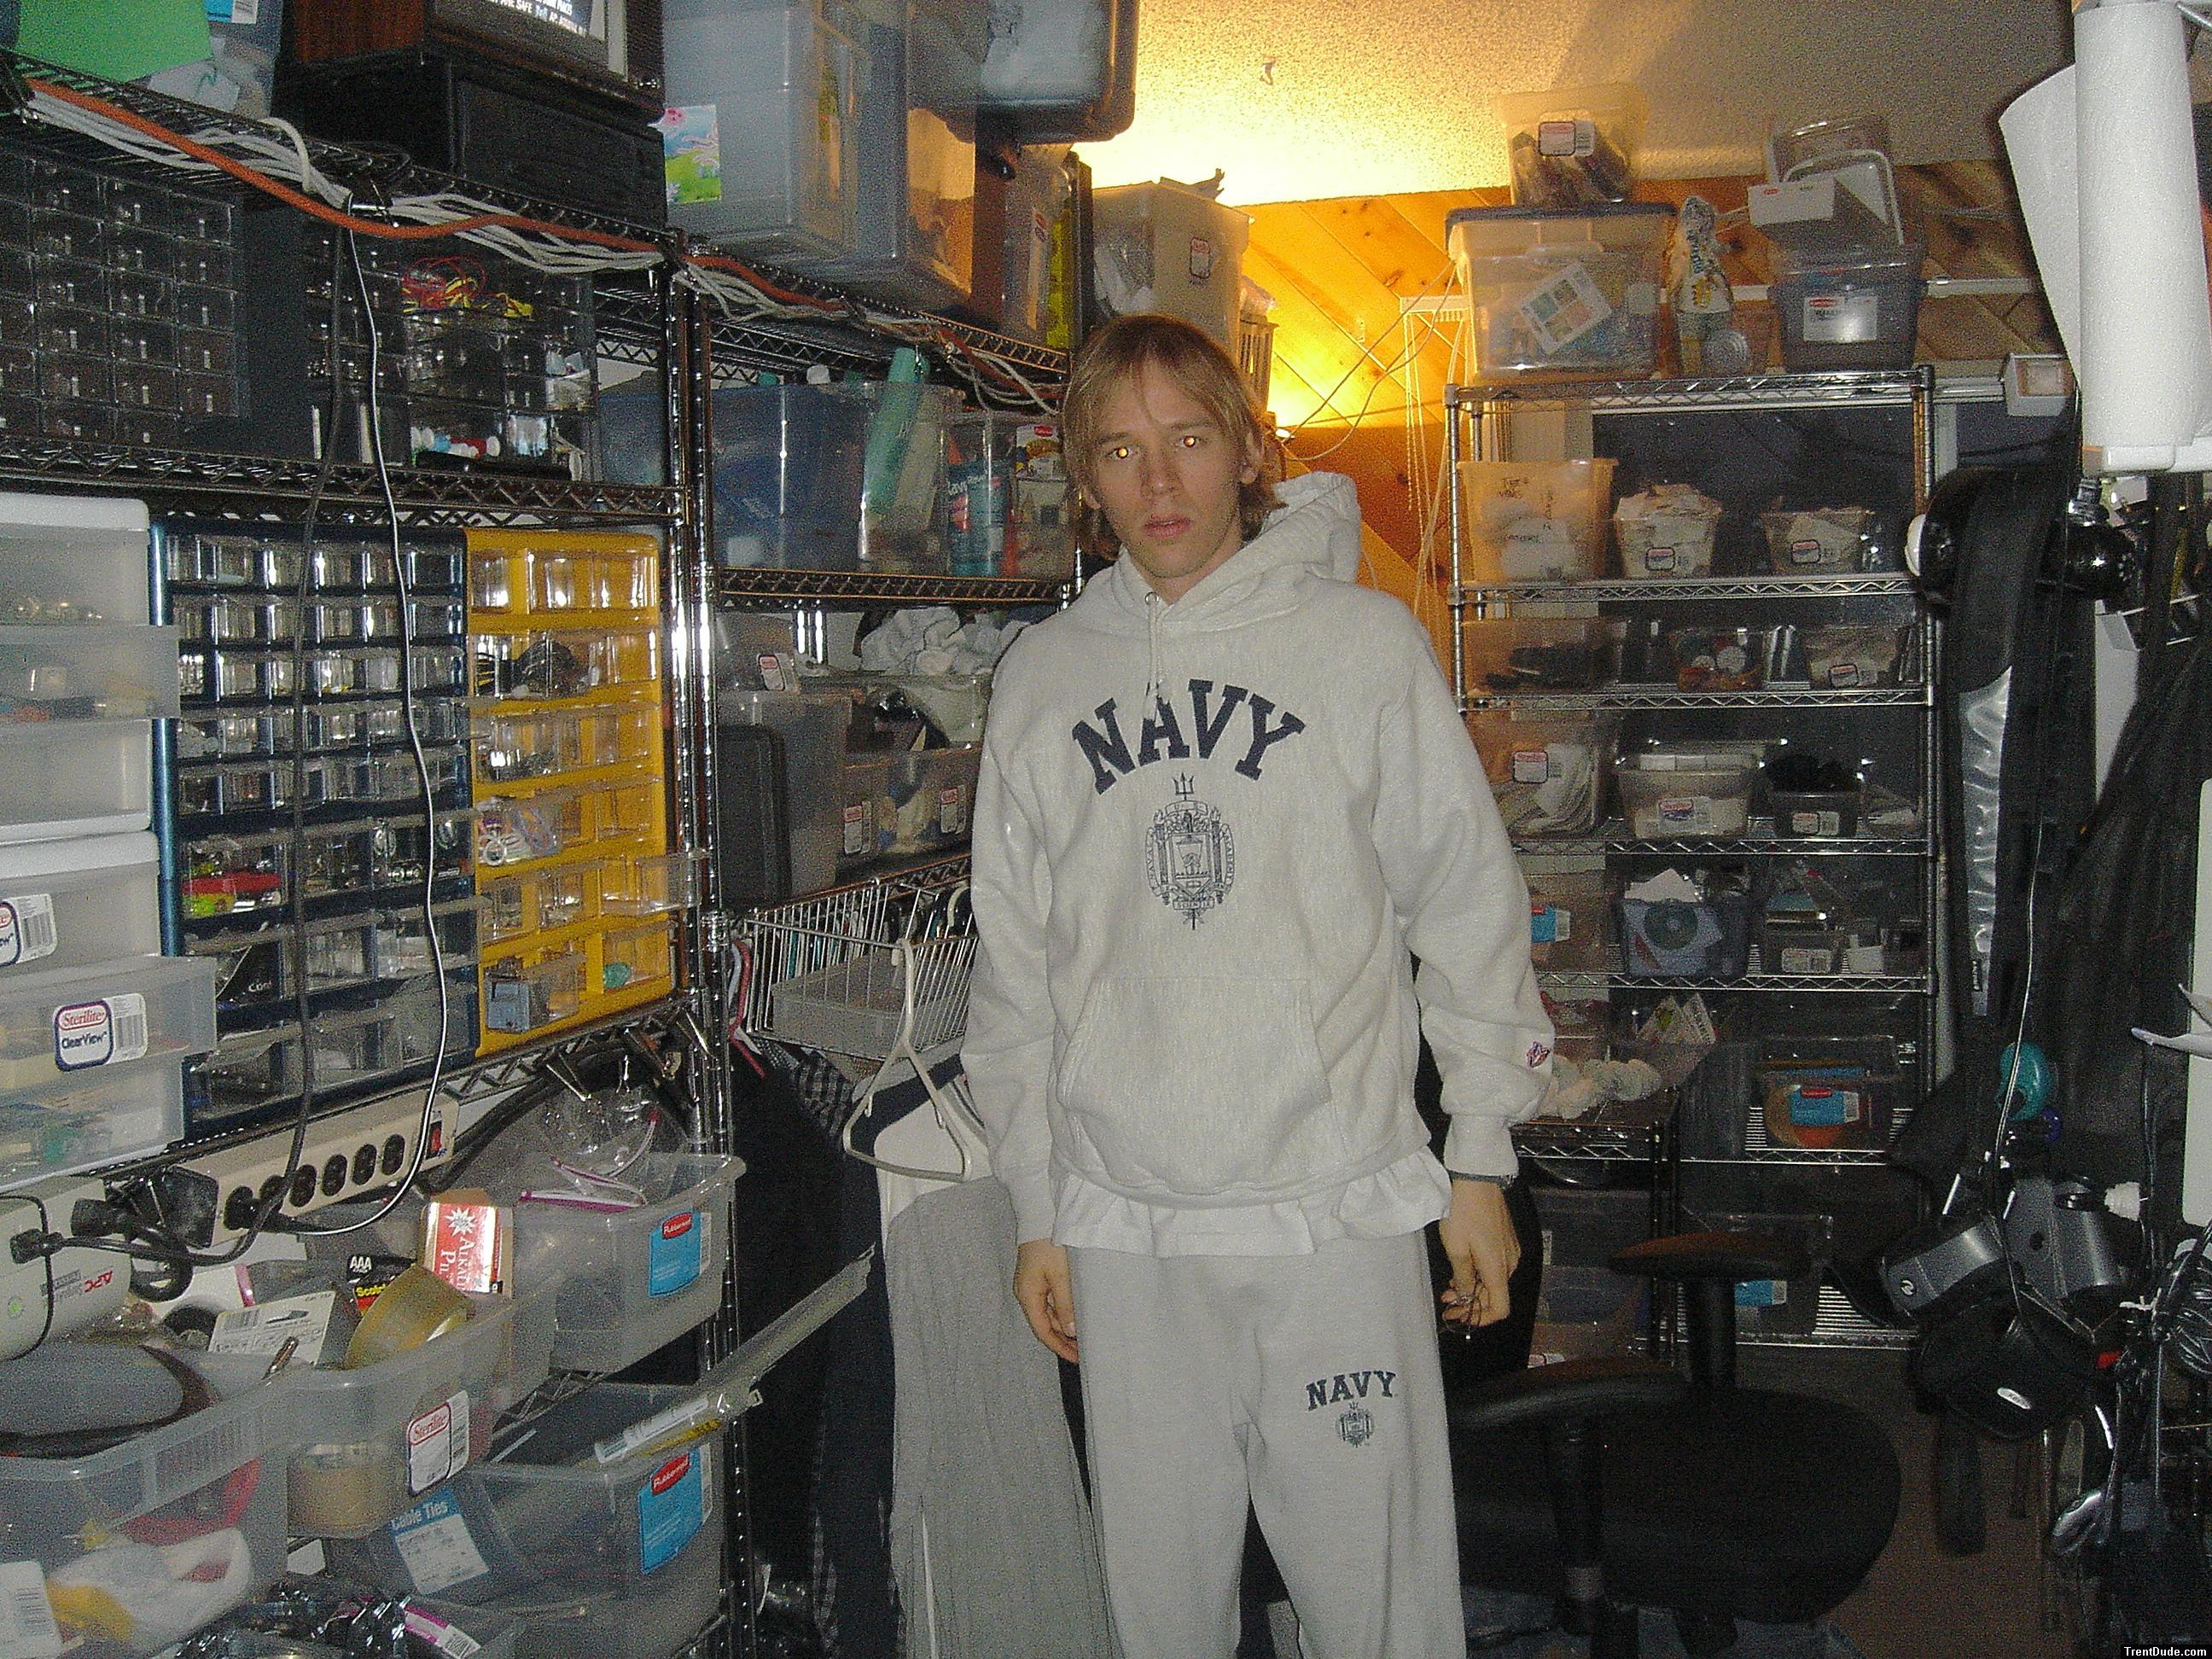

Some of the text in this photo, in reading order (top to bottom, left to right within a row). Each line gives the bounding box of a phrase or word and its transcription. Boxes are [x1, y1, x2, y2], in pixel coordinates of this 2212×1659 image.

[1071, 678, 1307, 795] NAVY
[64, 1010, 103, 1027] Sterilite
[349, 1255, 372, 1271] AAA
[84, 1269, 114, 1294] APC
[1306, 1370, 1397, 1412] NAVY
